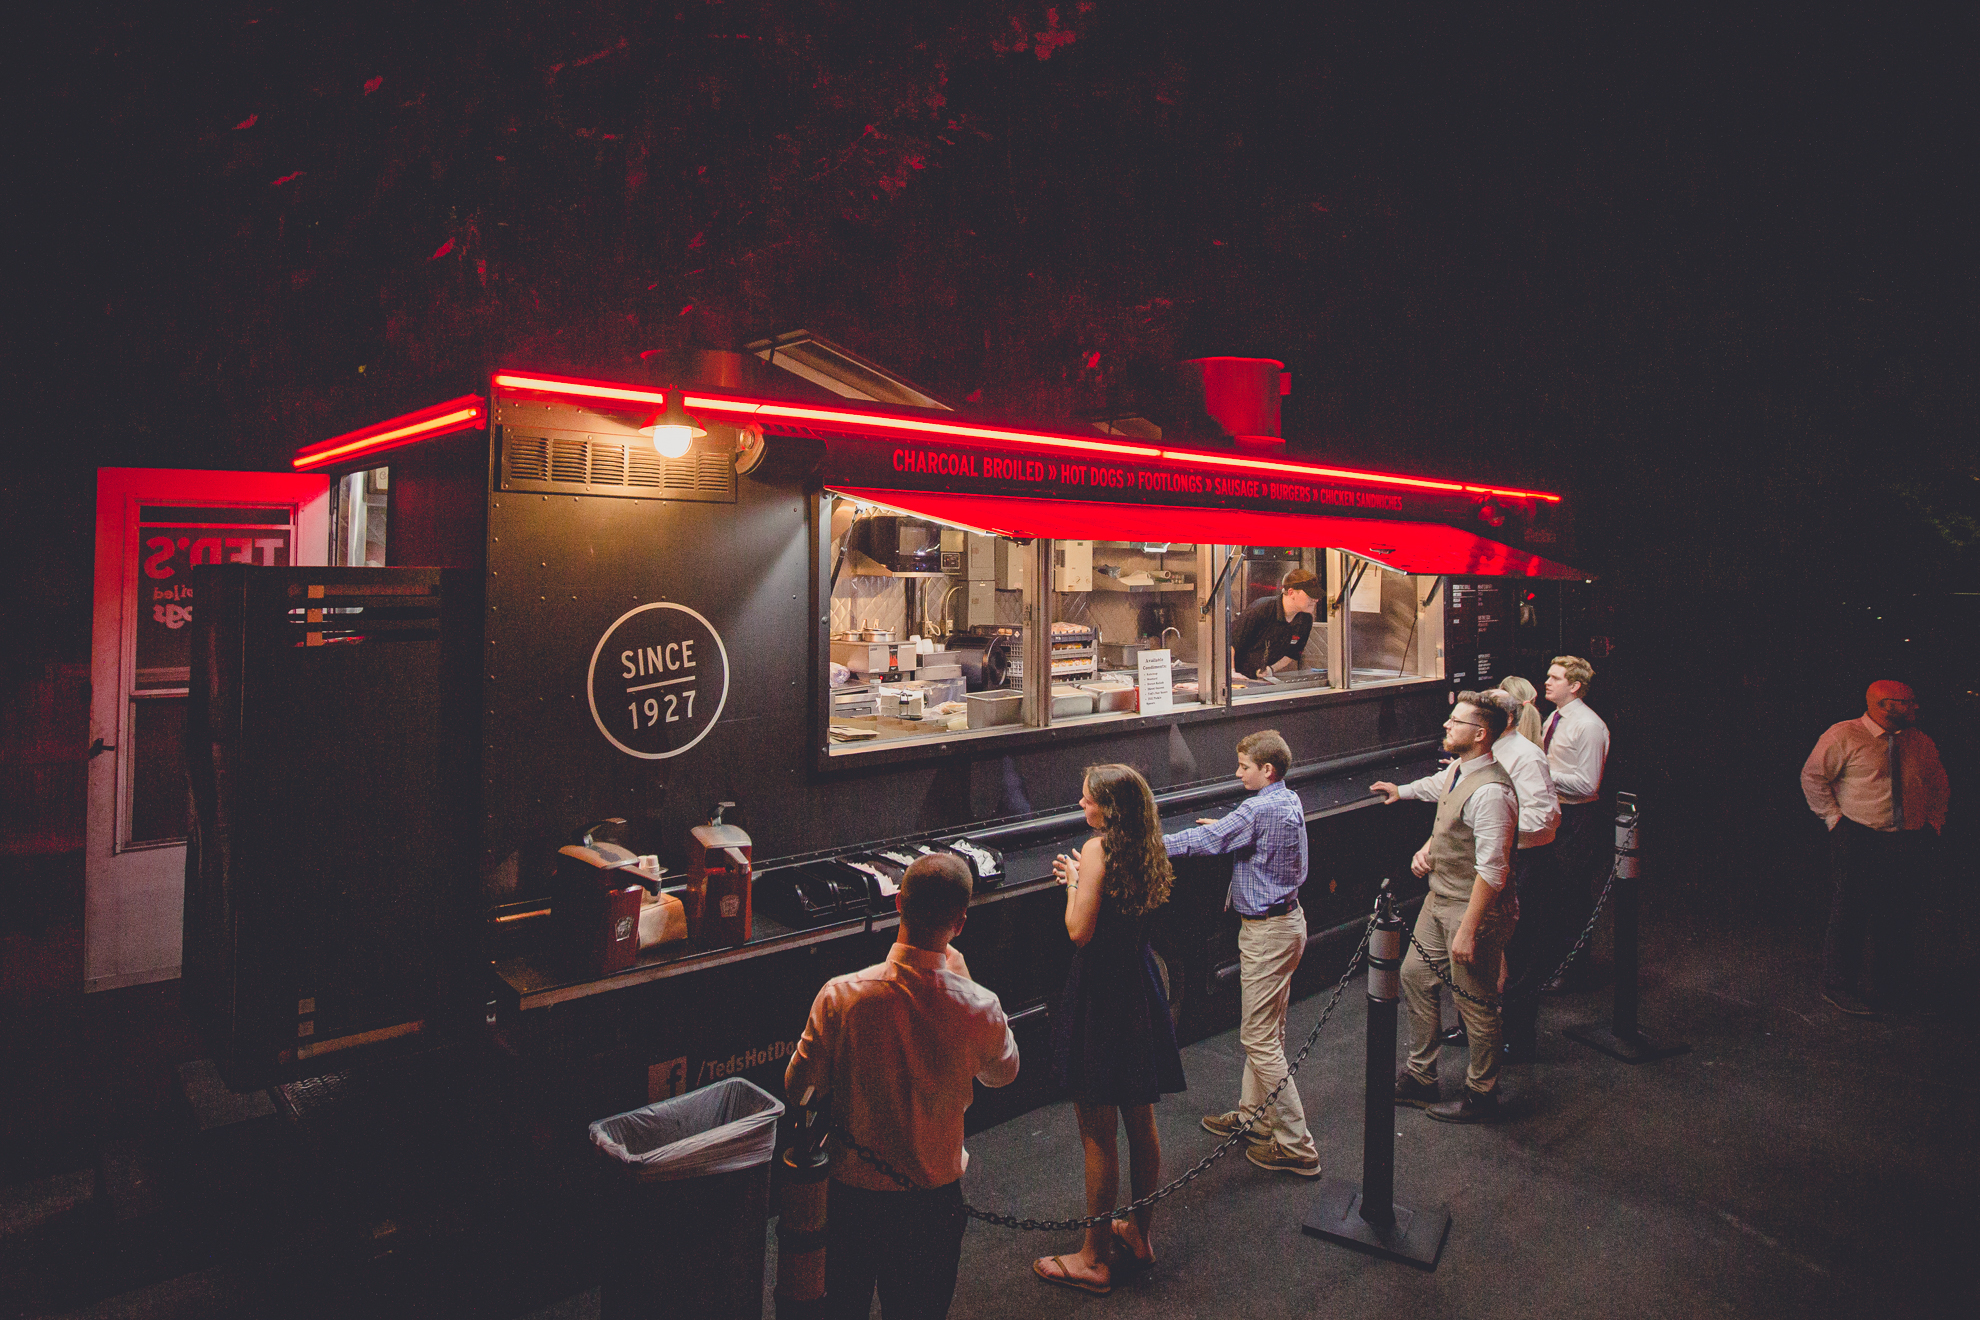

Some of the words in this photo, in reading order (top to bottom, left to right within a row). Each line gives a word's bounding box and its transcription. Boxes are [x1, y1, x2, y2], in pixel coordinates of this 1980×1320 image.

[893, 448, 978, 477] CHARCOAL
[983, 457, 1044, 482] BROILED
[1061, 464, 1086, 485] HOT
[1090, 466, 1124, 488] DOGS
[1138, 471, 1203, 493] FOOTLONGS
[1215, 477, 1260, 498] SAUSAGE
[1270, 482, 1311, 503] BURGERS
[1320, 488, 1355, 507] CHICKEN
[1356, 491, 1402, 511] SANDWICHES
[620, 639, 696, 679] SINCE
[628, 690, 696, 730] 1927
[696, 1040, 796, 1086] /TedsHotDo
